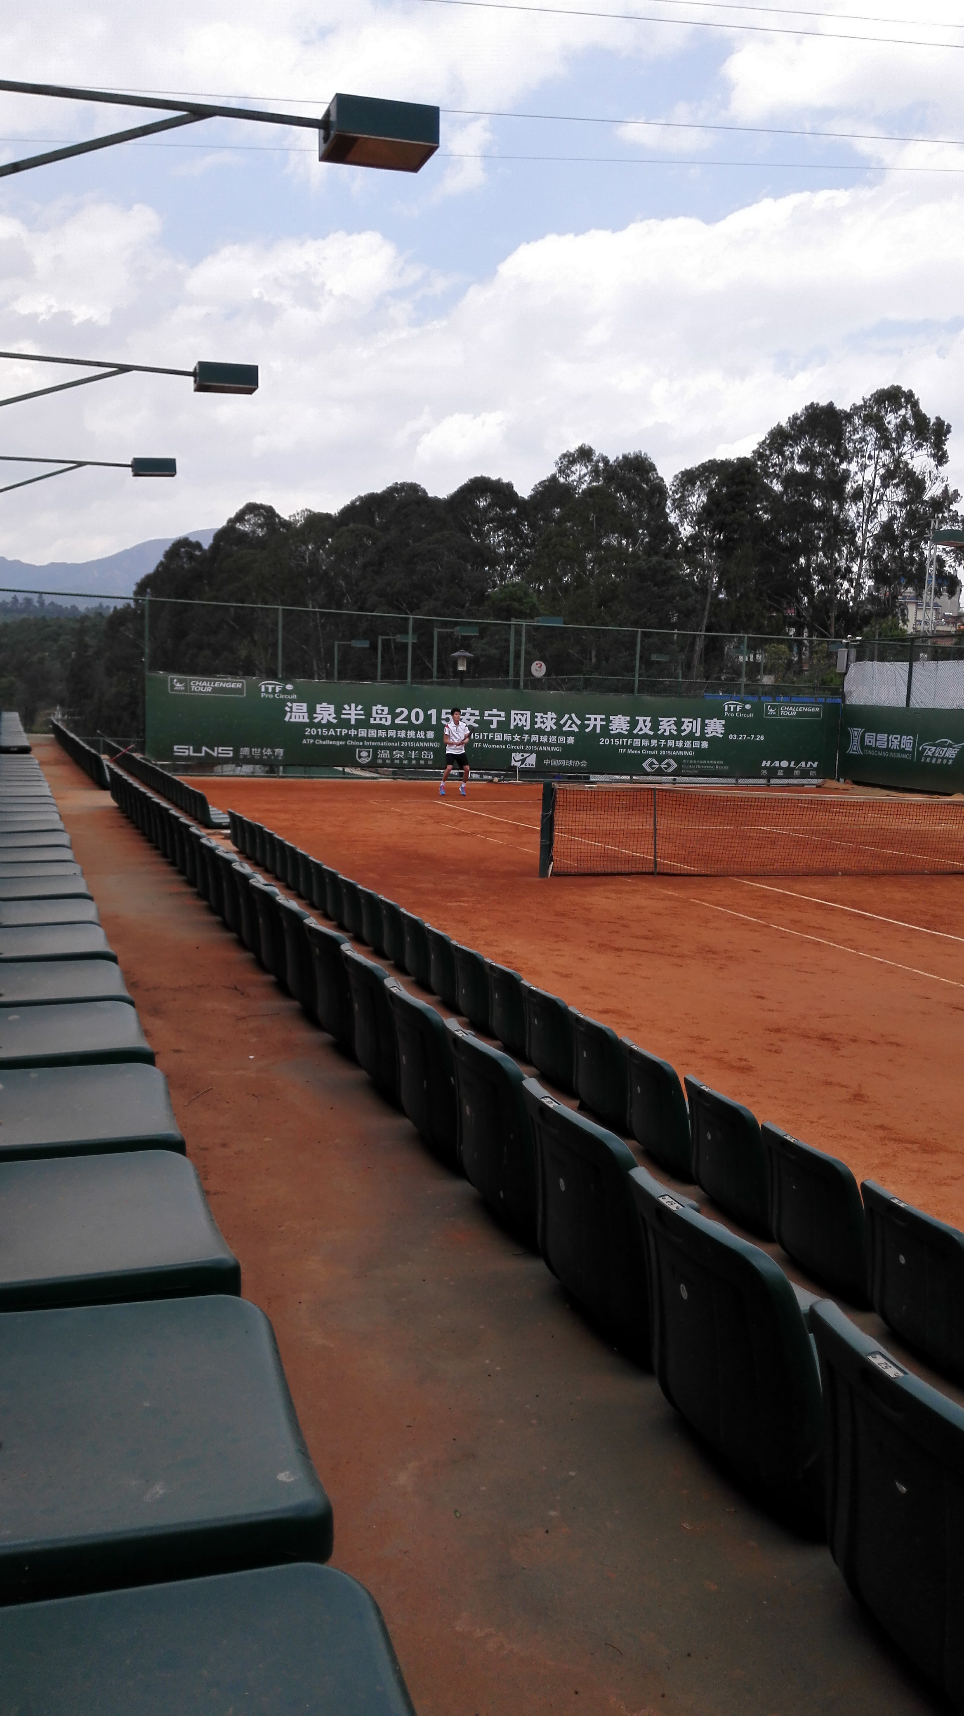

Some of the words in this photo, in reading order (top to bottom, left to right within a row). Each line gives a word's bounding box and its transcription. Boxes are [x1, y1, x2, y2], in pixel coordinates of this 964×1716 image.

[190, 680, 242, 688] CHALLENGER
[261, 684, 283, 692] ITF
[305, 728, 435, 739] 2015ATP中国国际网球挑战赛
[378, 750, 433, 759] 温泉半岛
